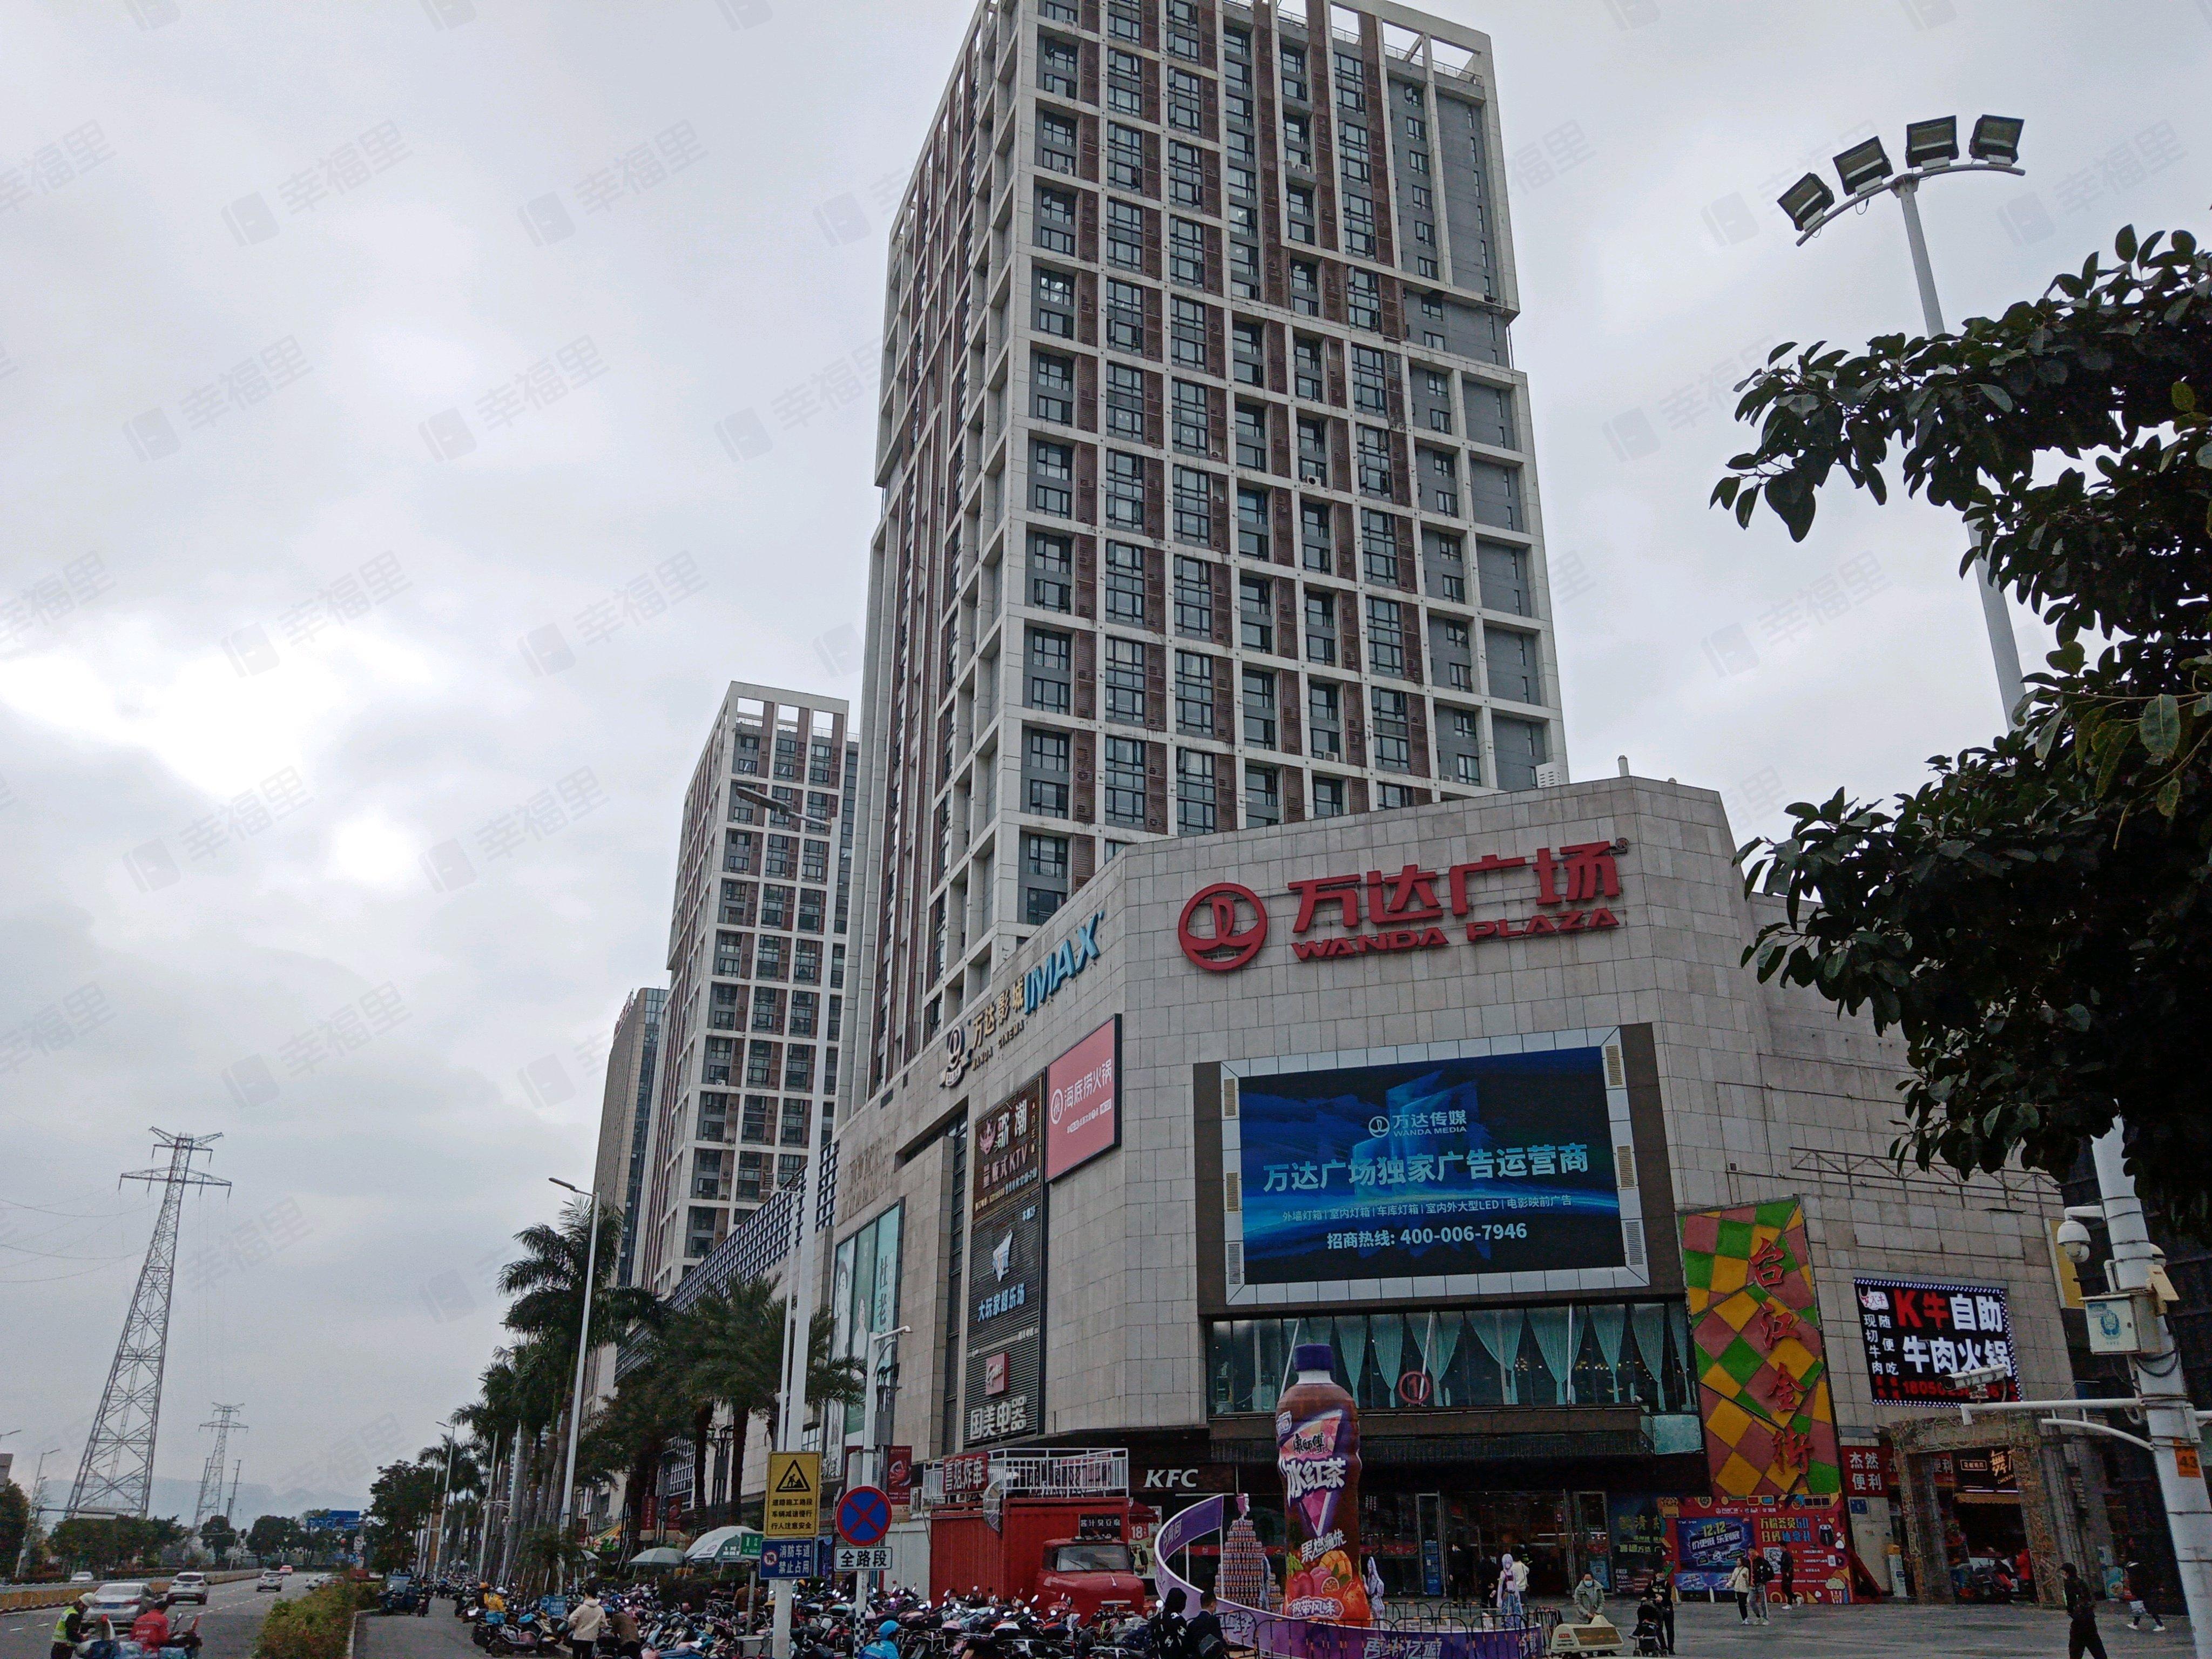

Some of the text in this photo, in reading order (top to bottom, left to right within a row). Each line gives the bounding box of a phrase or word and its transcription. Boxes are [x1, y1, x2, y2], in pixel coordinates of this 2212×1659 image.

[1288, 841, 1620, 933] 万达广场
[1291, 908, 1619, 960] WANDA PLAZA
[1024, 913, 1100, 1015] IMAX
[973, 975, 1026, 1050] 万达影城
[1064, 1058, 1111, 1111] 海底捞火锅
[1393, 1110, 1467, 1128] 万达传媒
[1394, 1125, 1467, 1137] WANDA MEDIA
[1263, 1142, 1589, 1192] 万达广场独家广告运营商
[1282, 1194, 1572, 1222] 外墙灯箱 室内灯箱 车库灯箱 室内外大型LED 电影映前广告
[1327, 1223, 1527, 1249] 招商热线: 400-006-7946
[978, 1283, 1024, 1322] 大玩家超乐场
[1894, 1289, 2003, 1332] K牛自助
[1863, 1314, 1883, 1374] 现切牛肉
[1878, 1314, 1899, 1375] 随便吃
[1903, 1336, 2013, 1377] 牛肉火锅
[970, 1395, 1027, 1440] 国美电器
[1850, 1452, 1879, 1469] 杰然
[1143, 1469, 1198, 1488] KFC
[1282, 1457, 1346, 1507] 冰红茶
[1852, 1473, 1881, 1491] 便利
[772, 1510, 812, 1518] 车辆减速慢行
[1131, 1525, 1143, 1539] 18
[1692, 1530, 1740, 1550] 价更低 乐到底
[1703, 1521, 1727, 1537] 12.12
[779, 1544, 811, 1557] 消防车道
[840, 1550, 887, 1567] 全路段
[778, 1560, 810, 1574] 禁止占用
[1292, 1598, 1336, 1617] 热带风味
